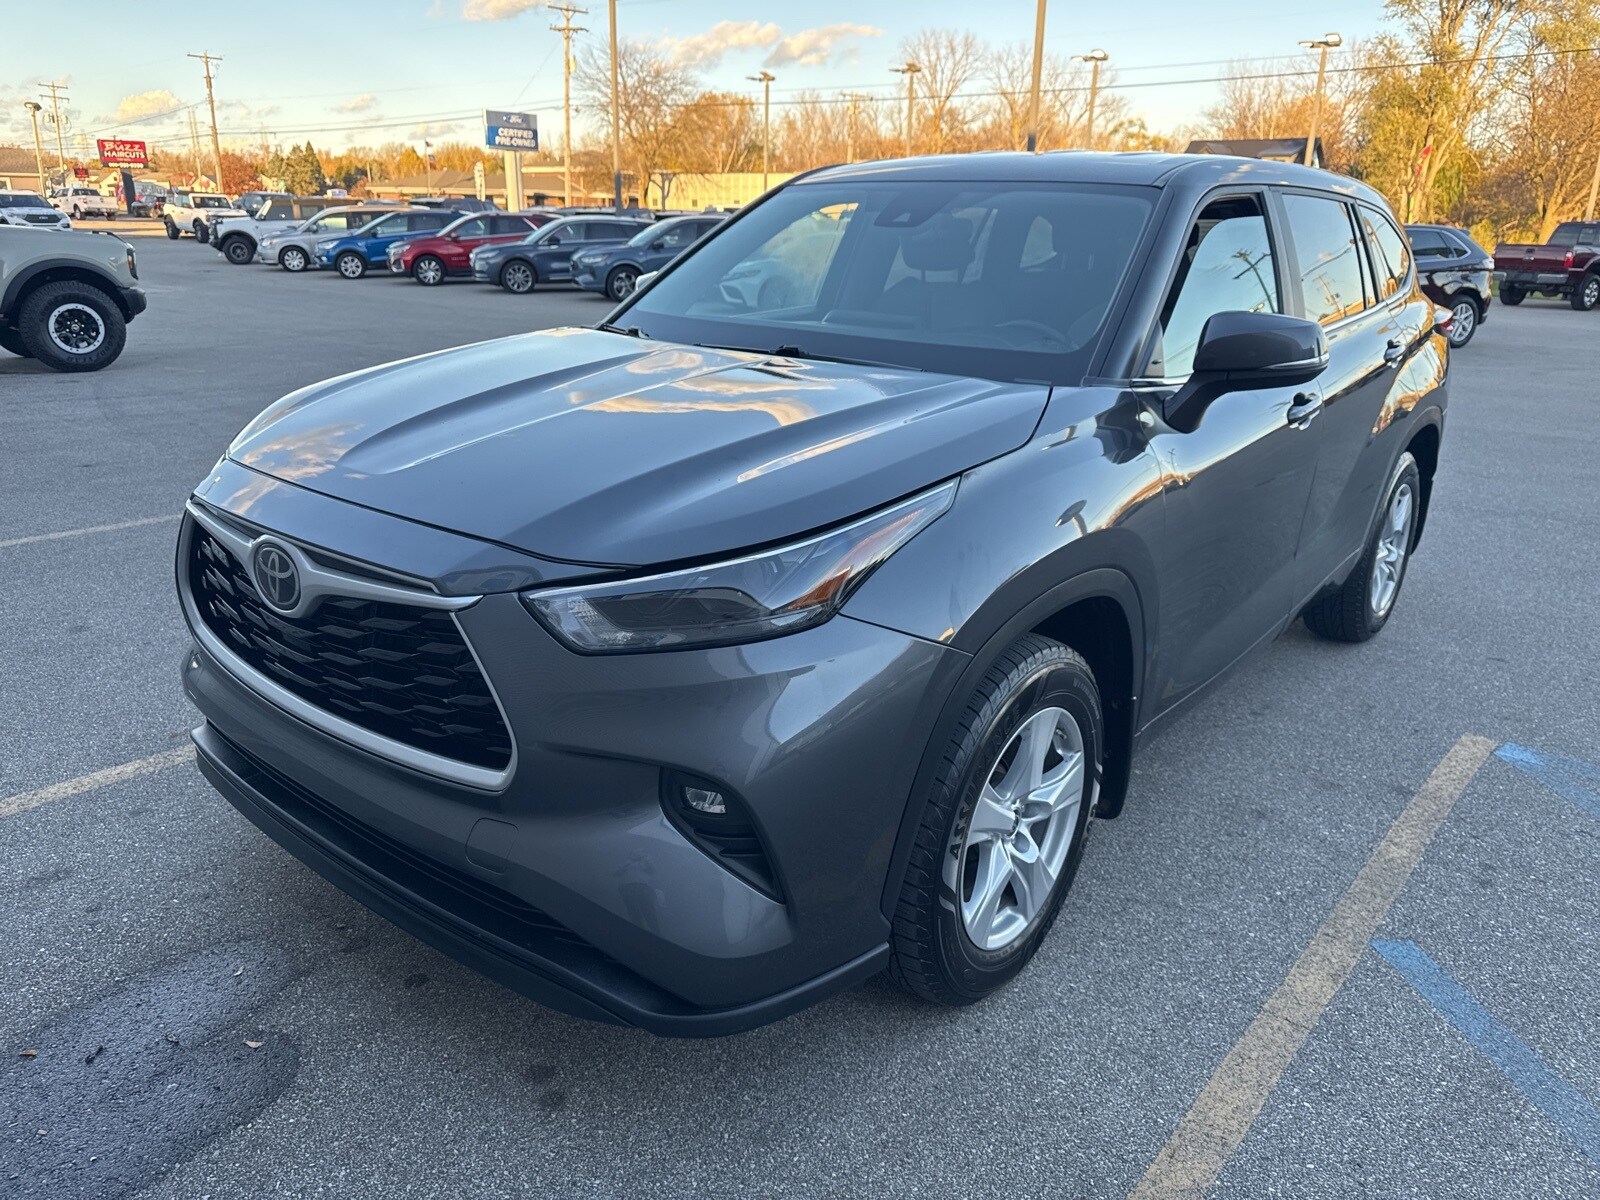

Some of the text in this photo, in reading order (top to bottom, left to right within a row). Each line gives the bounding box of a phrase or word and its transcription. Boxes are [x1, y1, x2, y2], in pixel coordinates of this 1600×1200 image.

[498, 127, 533, 138] CERTIFIED
[103, 141, 144, 152] Buzz
[495, 136, 535, 147] PRE-OWNED
[104, 150, 146, 159] HAIRCUTS
